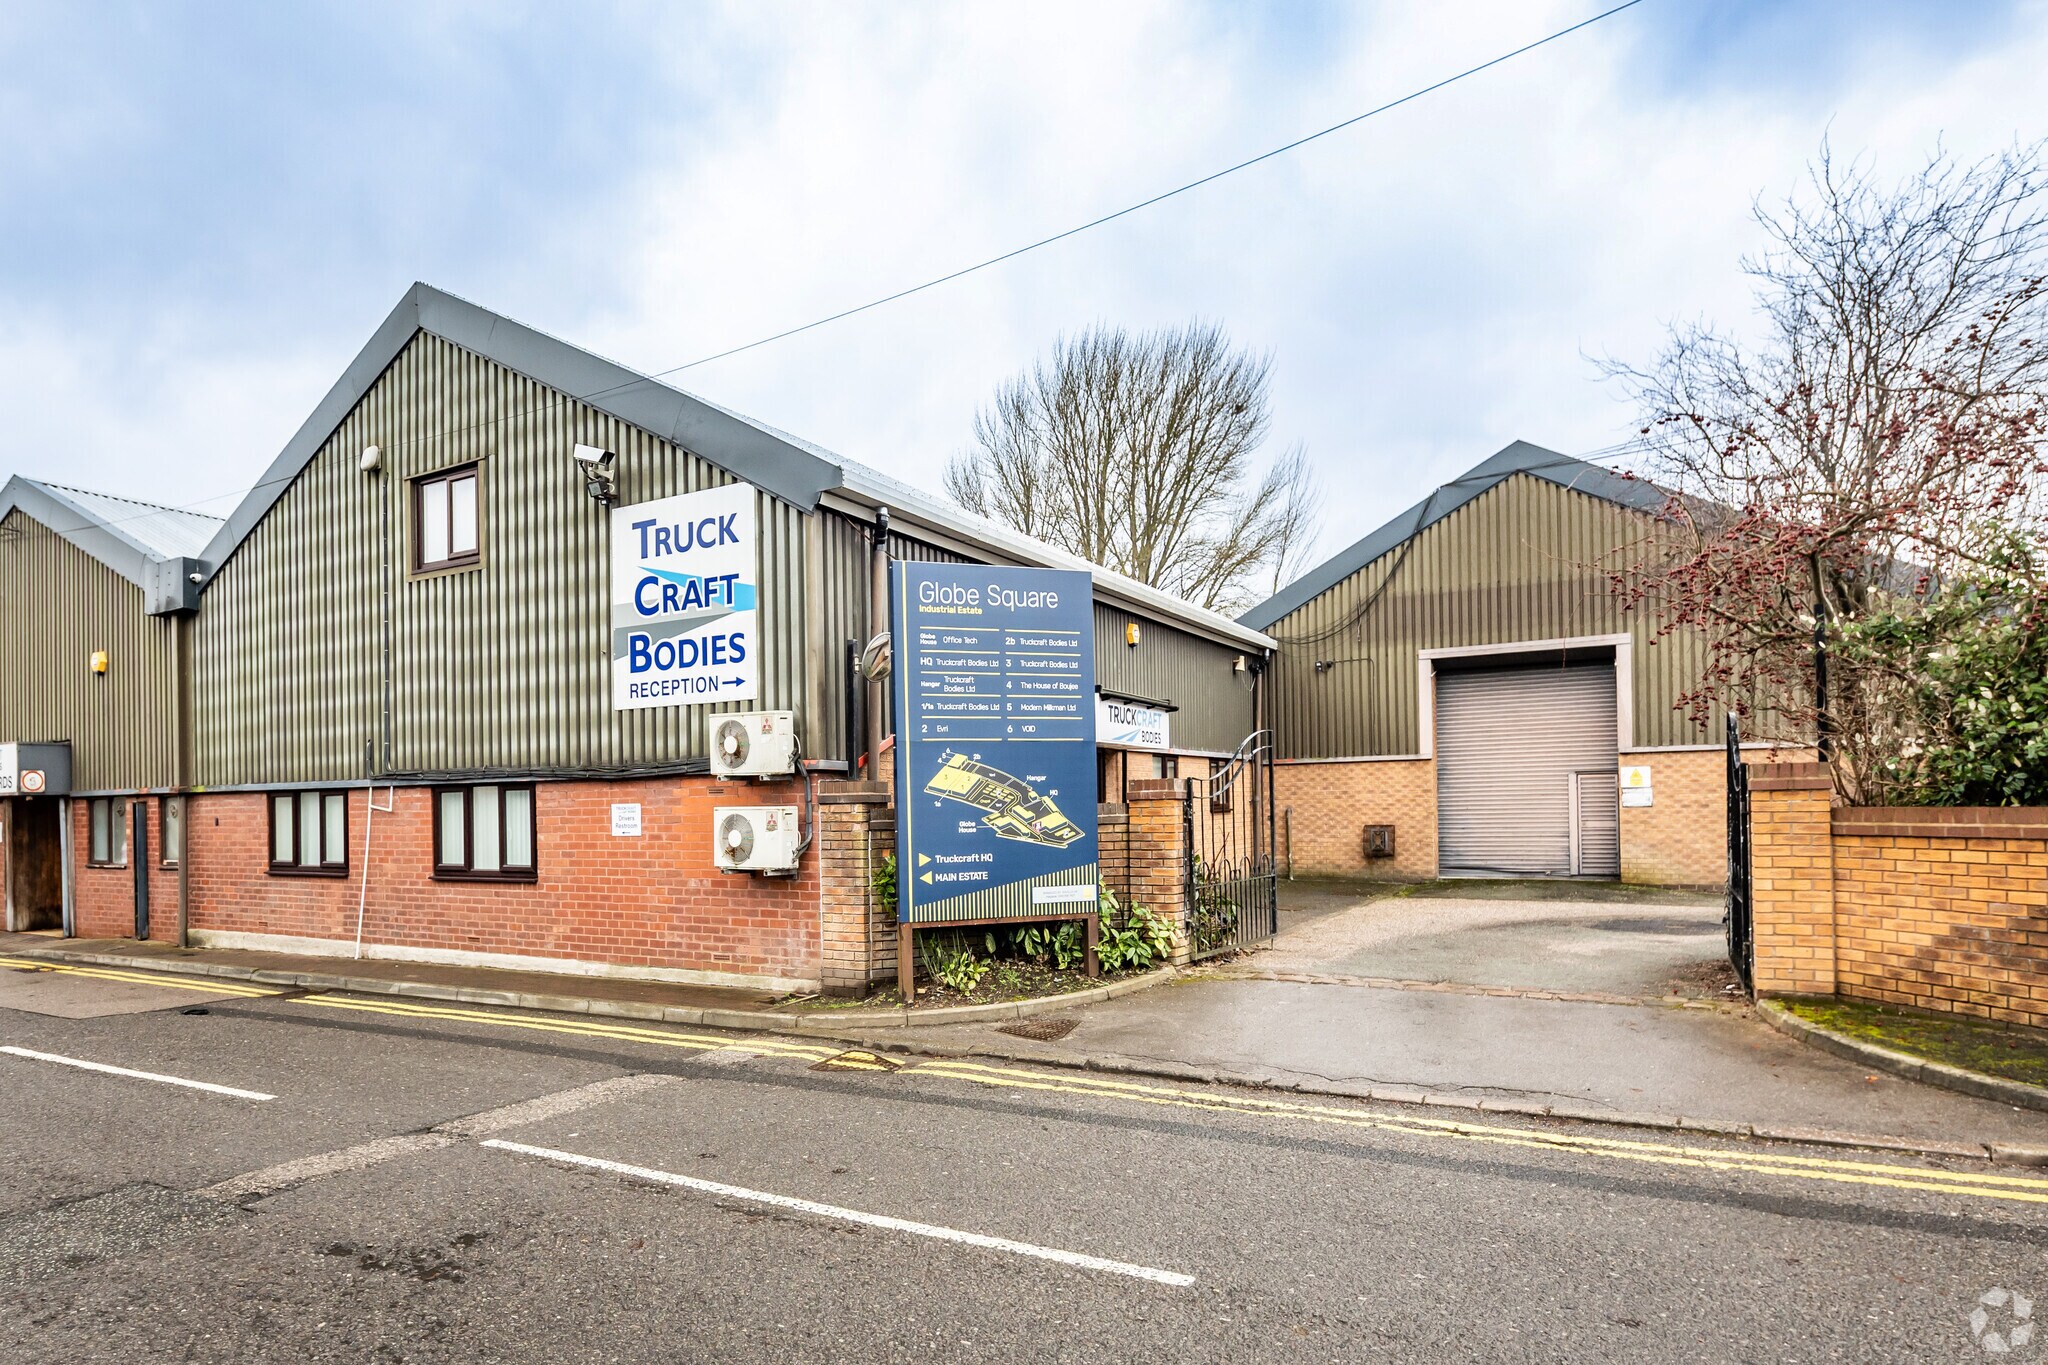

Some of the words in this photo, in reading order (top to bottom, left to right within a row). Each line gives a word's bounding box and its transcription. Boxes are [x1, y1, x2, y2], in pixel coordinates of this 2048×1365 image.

[632, 513, 739, 559] TRUCK
[635, 573, 739, 616] CRAFT
[919, 580, 979, 605] Globe
[987, 584, 1059, 612] Square
[919, 605, 956, 614] Industrial
[957, 606, 983, 615] Estate
[943, 635, 962, 644] Office
[964, 636, 978, 644] Tech
[1005, 637, 1016, 646] 2b
[1020, 638, 1048, 646] Truckcraft
[629, 632, 746, 674] BODIES
[920, 657, 932, 666] HQ
[936, 658, 966, 666] Truckcraft
[1006, 659, 1012, 667] 3
[630, 675, 719, 699] RECEPTION
[1006, 680, 1012, 689] 4
[1060, 682, 1079, 691] Boujee
[1006, 703, 1012, 711] 5
[1108, 704, 1162, 728] TRUCKCRAFT
[922, 724, 928, 732] 2
[1007, 725, 1013, 733] 6
[1142, 730, 1162, 744] BODIES
[935, 854, 979, 864] Truckcraft
[981, 853, 993, 862] HQ
[935, 873, 957, 882] MAIN
[959, 871, 988, 881] ESTATE
